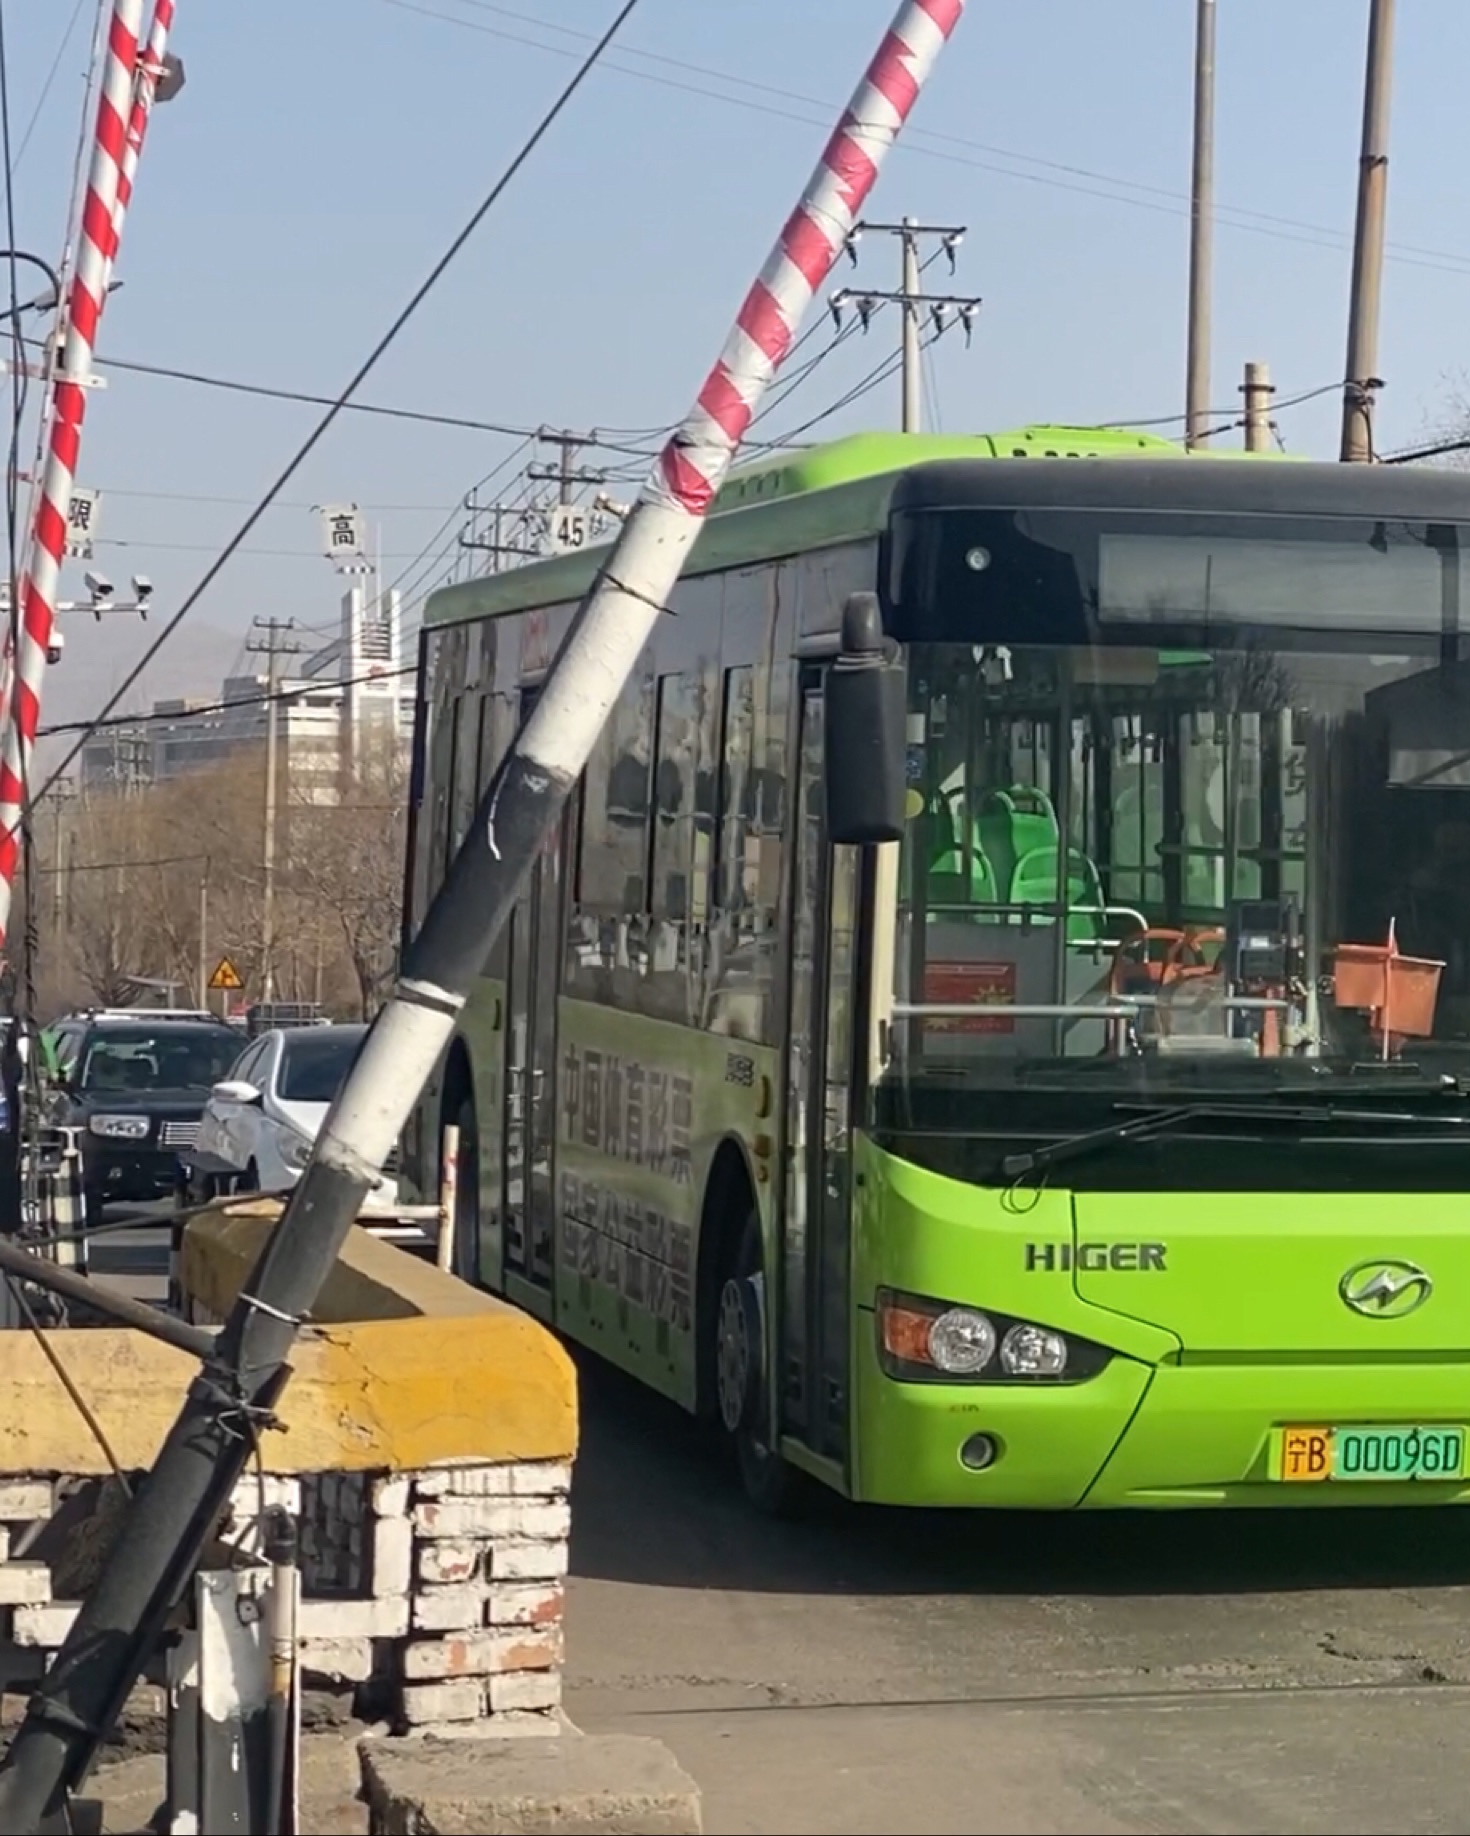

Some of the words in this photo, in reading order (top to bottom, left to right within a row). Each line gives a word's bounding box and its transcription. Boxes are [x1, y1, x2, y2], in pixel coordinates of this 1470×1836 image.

[69, 497, 92, 531] 限
[329, 513, 355, 546] 高
[563, 1042, 694, 1185] 中国体育彩票
[1025, 1243, 1168, 1271] HIGER
